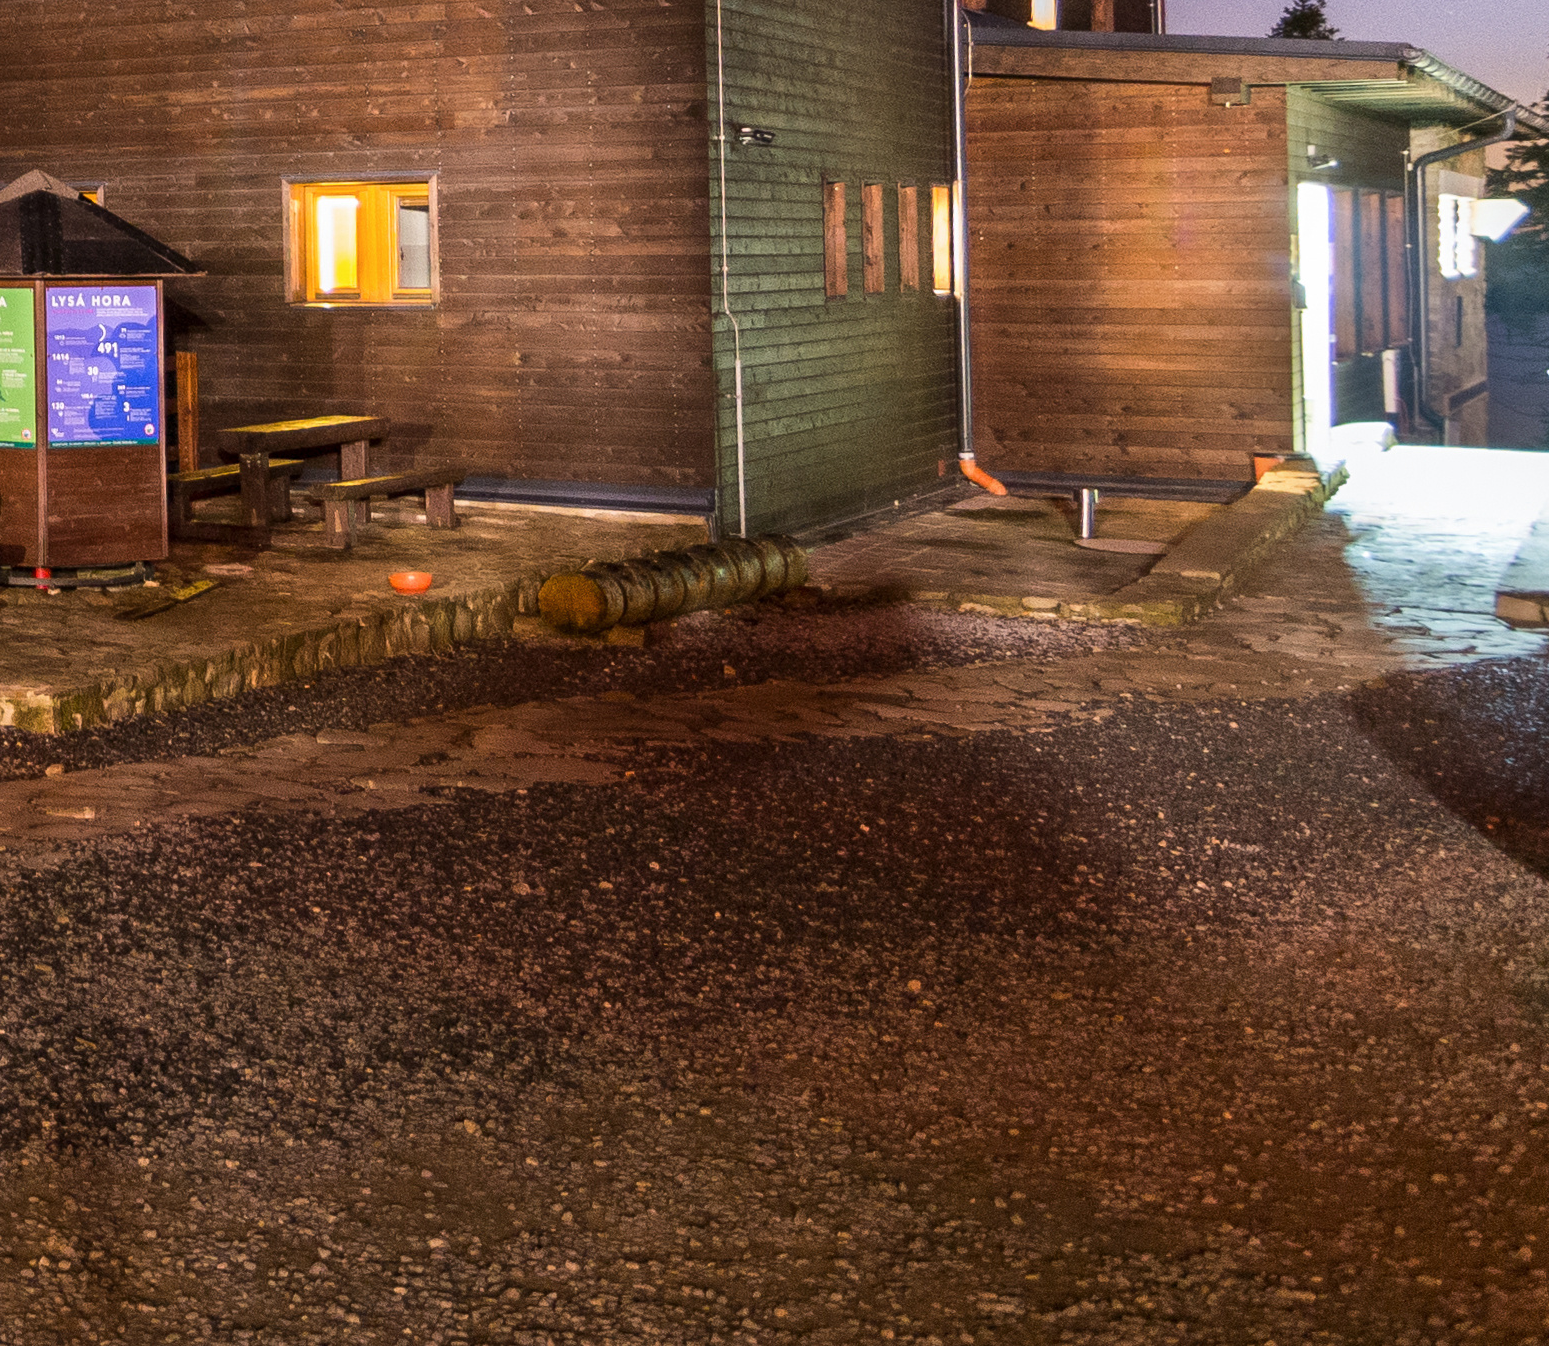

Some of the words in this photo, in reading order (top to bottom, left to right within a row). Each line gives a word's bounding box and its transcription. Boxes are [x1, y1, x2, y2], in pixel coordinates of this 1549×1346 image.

[51, 292, 86, 307] LYSÁ
[91, 295, 132, 307] HORA
[97, 342, 119, 355] 491
[87, 366, 99, 376] 30
